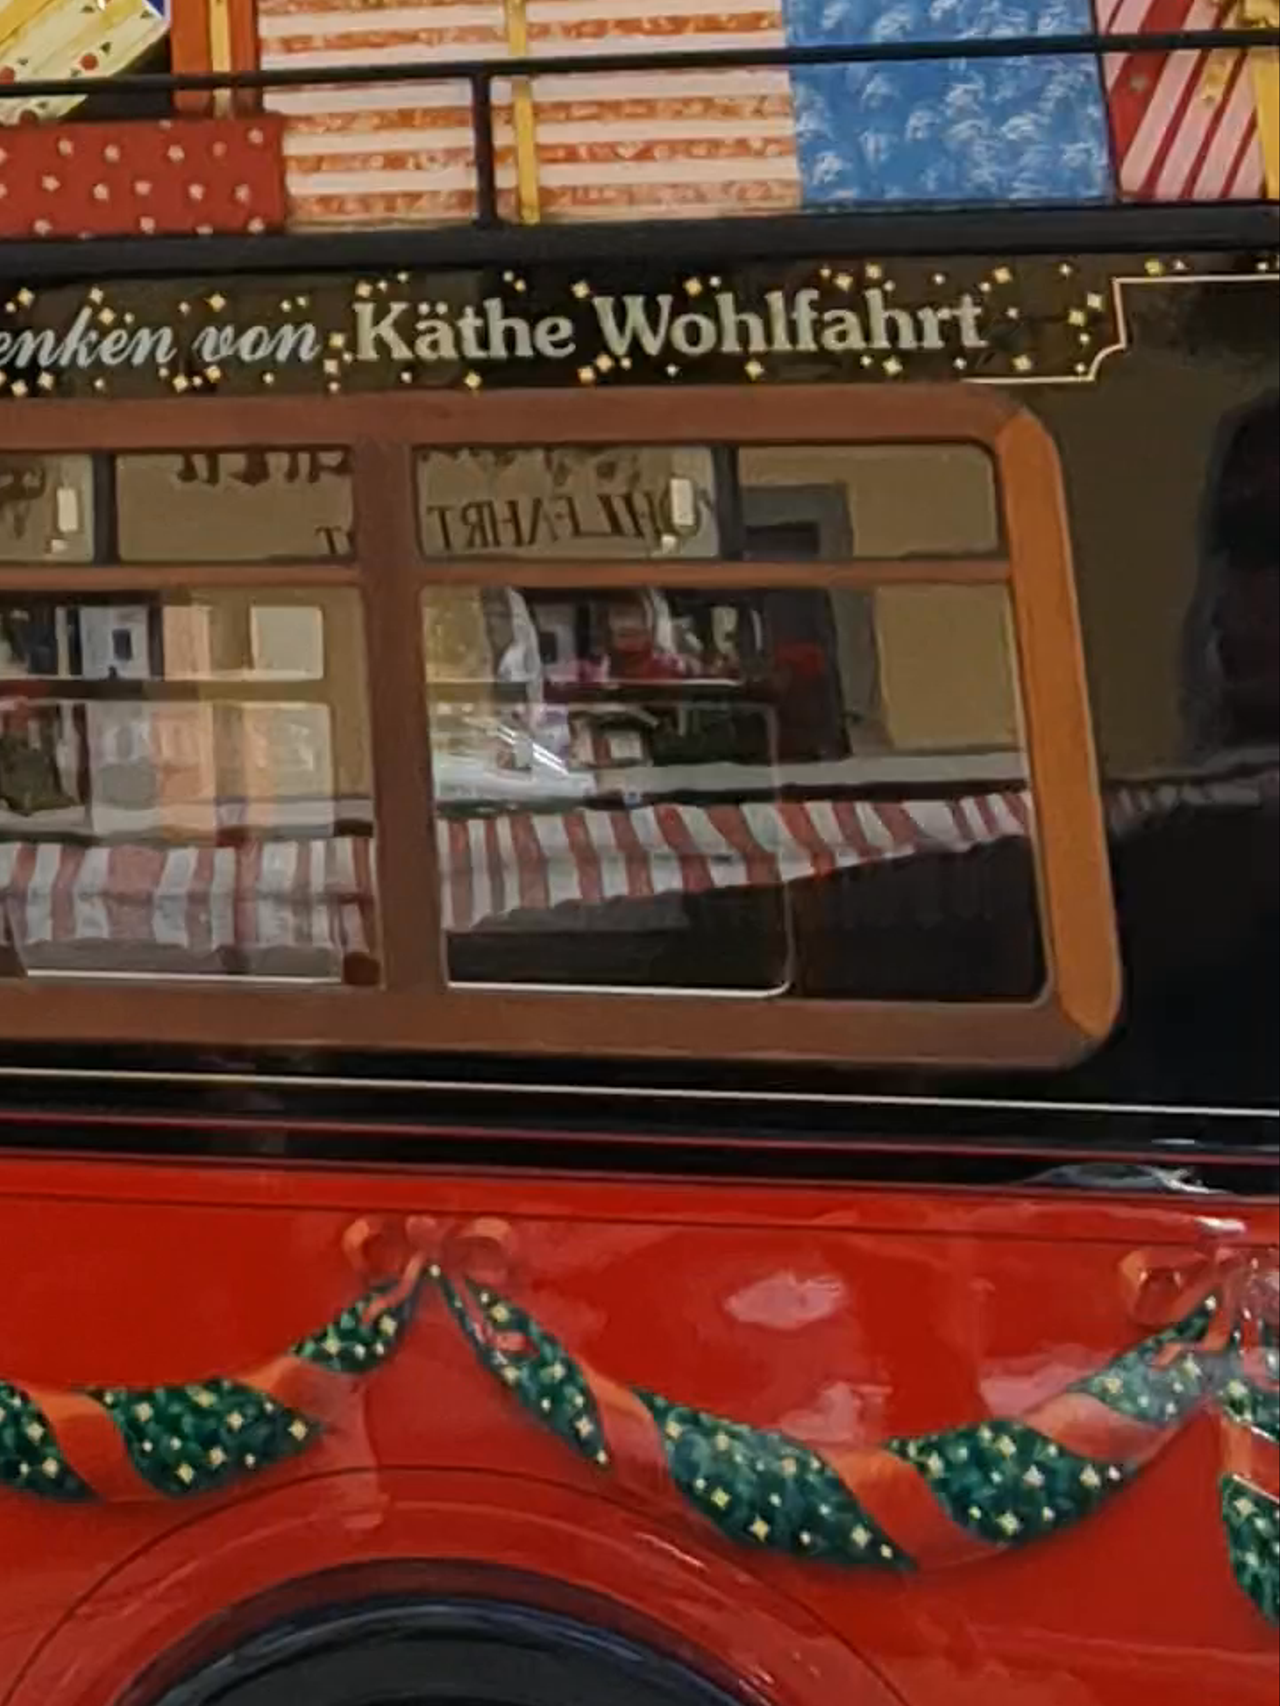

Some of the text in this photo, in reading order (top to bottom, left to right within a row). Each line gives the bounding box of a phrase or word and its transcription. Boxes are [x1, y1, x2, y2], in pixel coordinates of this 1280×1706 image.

[192, 321, 320, 364] von
[352, 297, 576, 362] Käthe
[592, 288, 989, 357] Wohlfahrt
